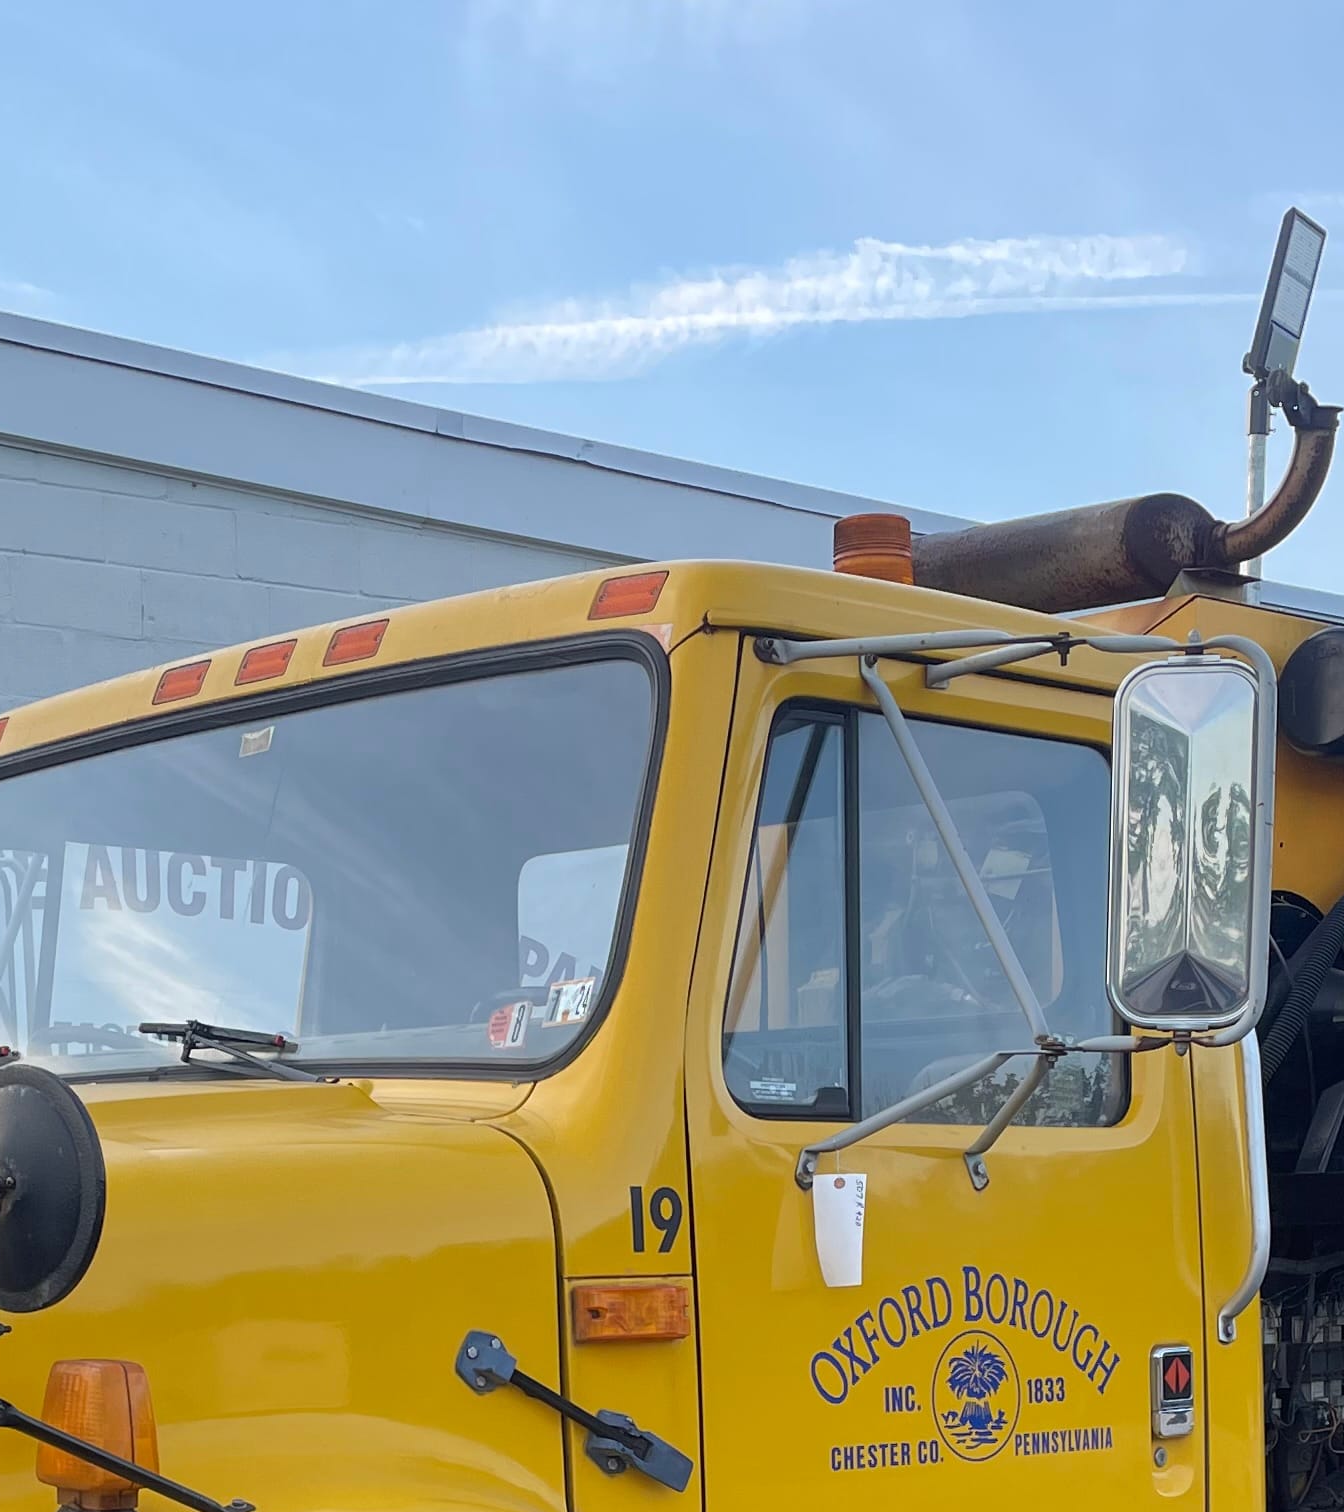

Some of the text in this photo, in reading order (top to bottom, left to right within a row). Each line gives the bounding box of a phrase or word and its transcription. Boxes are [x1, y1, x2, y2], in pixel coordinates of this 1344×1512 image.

[79, 843, 312, 931] AUCTIO
[630, 1186, 683, 1253] 19
[811, 1265, 1120, 1404] OXFORD BOROUGH
[884, 1377, 1065, 1412] INC. 1833
[831, 1427, 1113, 1471] CHESTER CO. PENNSYLVANIA
